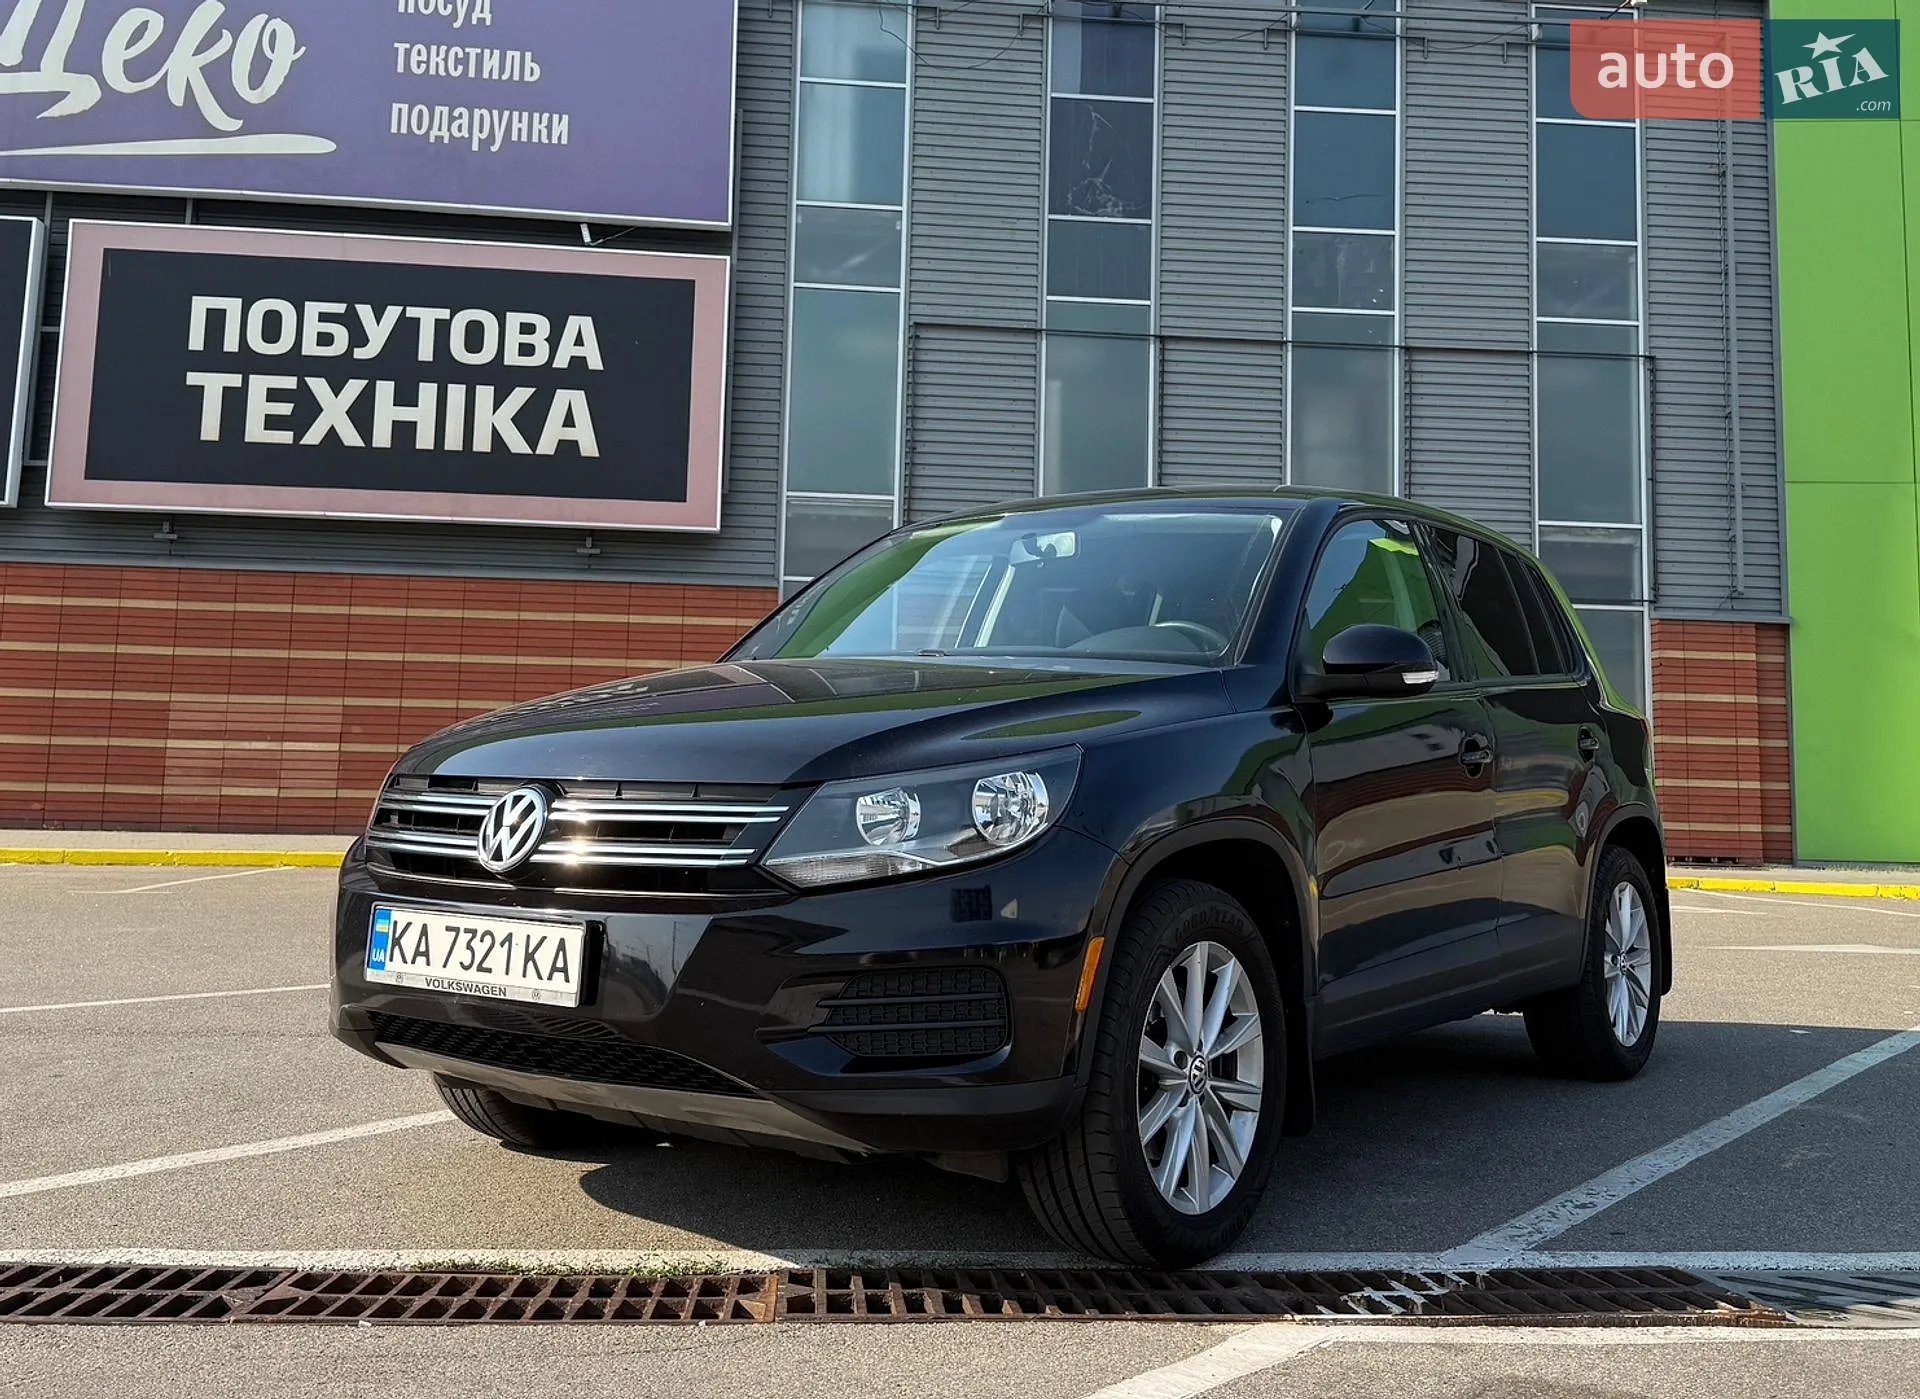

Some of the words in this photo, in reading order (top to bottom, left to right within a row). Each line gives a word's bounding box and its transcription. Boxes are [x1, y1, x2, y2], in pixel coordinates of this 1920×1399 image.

[394, 42, 541, 82] текстиль
[390, 102, 569, 152] подарунки
[187, 295, 604, 371] ПОБУТОВА
[186, 371, 600, 458] ТЕХНІКА
[372, 947, 385, 963] UA
[388, 920, 431, 967] KA
[442, 925, 513, 976] 7321
[522, 934, 570, 983] KA
[425, 977, 507, 998] VOLKSWAGEN
